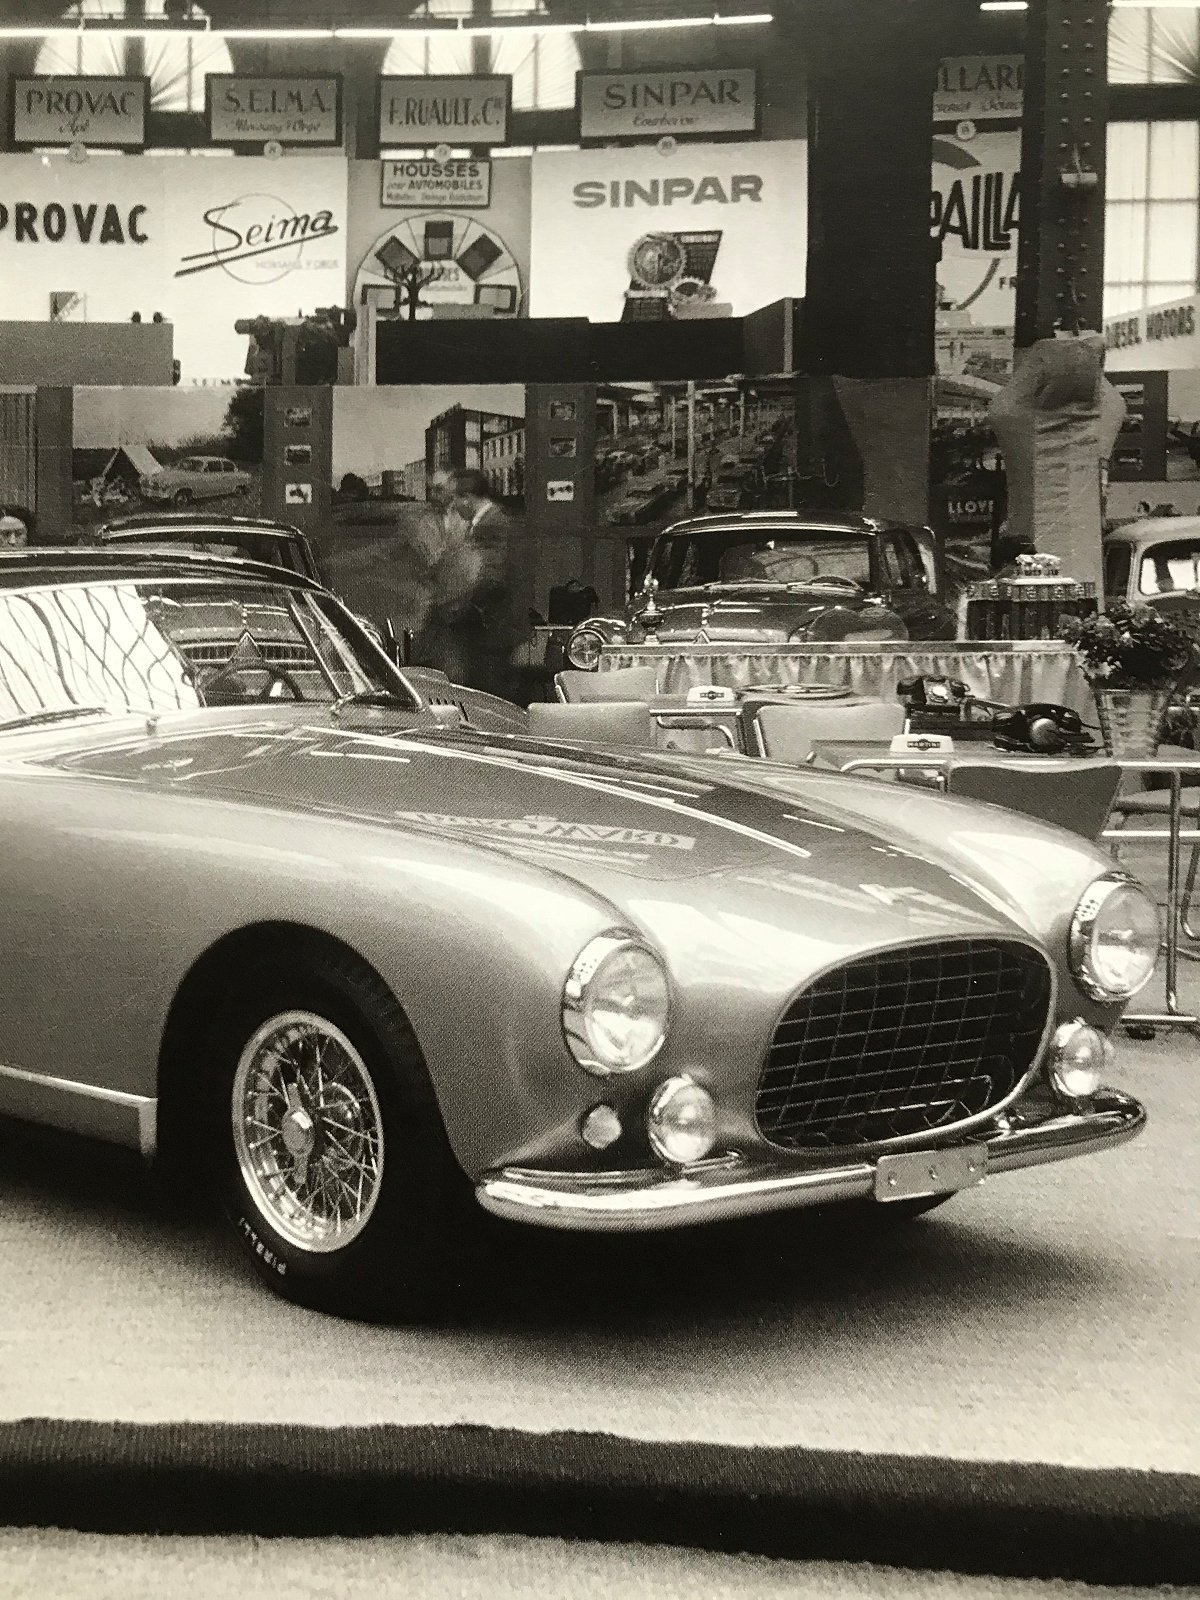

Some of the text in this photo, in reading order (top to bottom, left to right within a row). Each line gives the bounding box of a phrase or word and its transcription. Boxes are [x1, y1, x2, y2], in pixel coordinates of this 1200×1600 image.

[26, 88, 136, 116] PROVAC
[603, 79, 742, 109] SINPAR
[392, 163, 480, 178] HOUSSES
[407, 180, 483, 191] AUTOMOBILES
[573, 174, 764, 208] SINPAR
[1146, 305, 1195, 342] MOTORS
